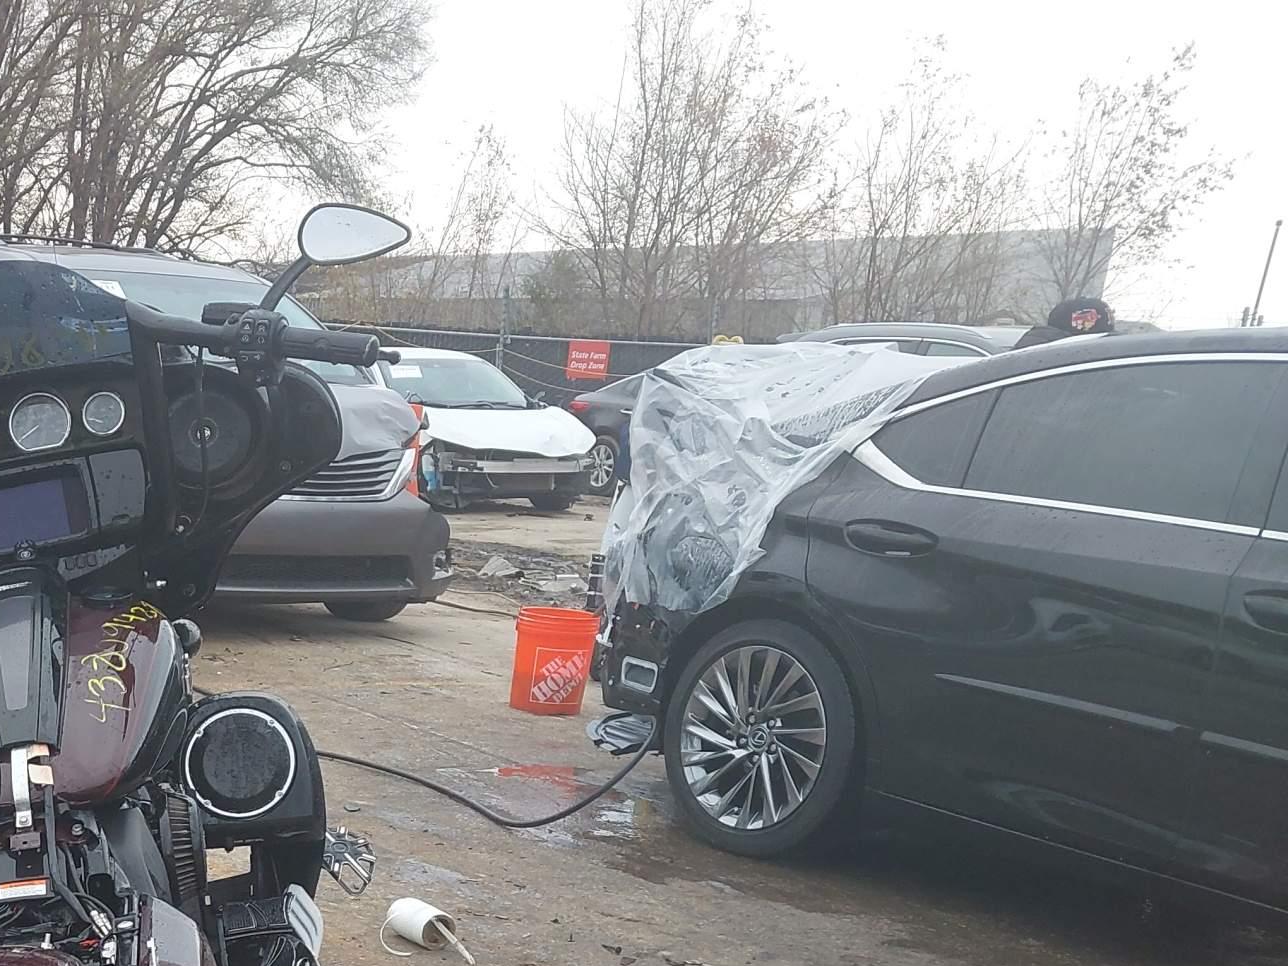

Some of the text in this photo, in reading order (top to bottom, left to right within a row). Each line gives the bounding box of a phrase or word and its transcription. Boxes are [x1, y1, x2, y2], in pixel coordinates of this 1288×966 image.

[570, 360, 605, 371] Drop Zone
[571, 350, 607, 360] State Farm
[532, 651, 586, 702] HOME
[540, 655, 566, 677] THE
[552, 672, 584, 703] DEPOT
